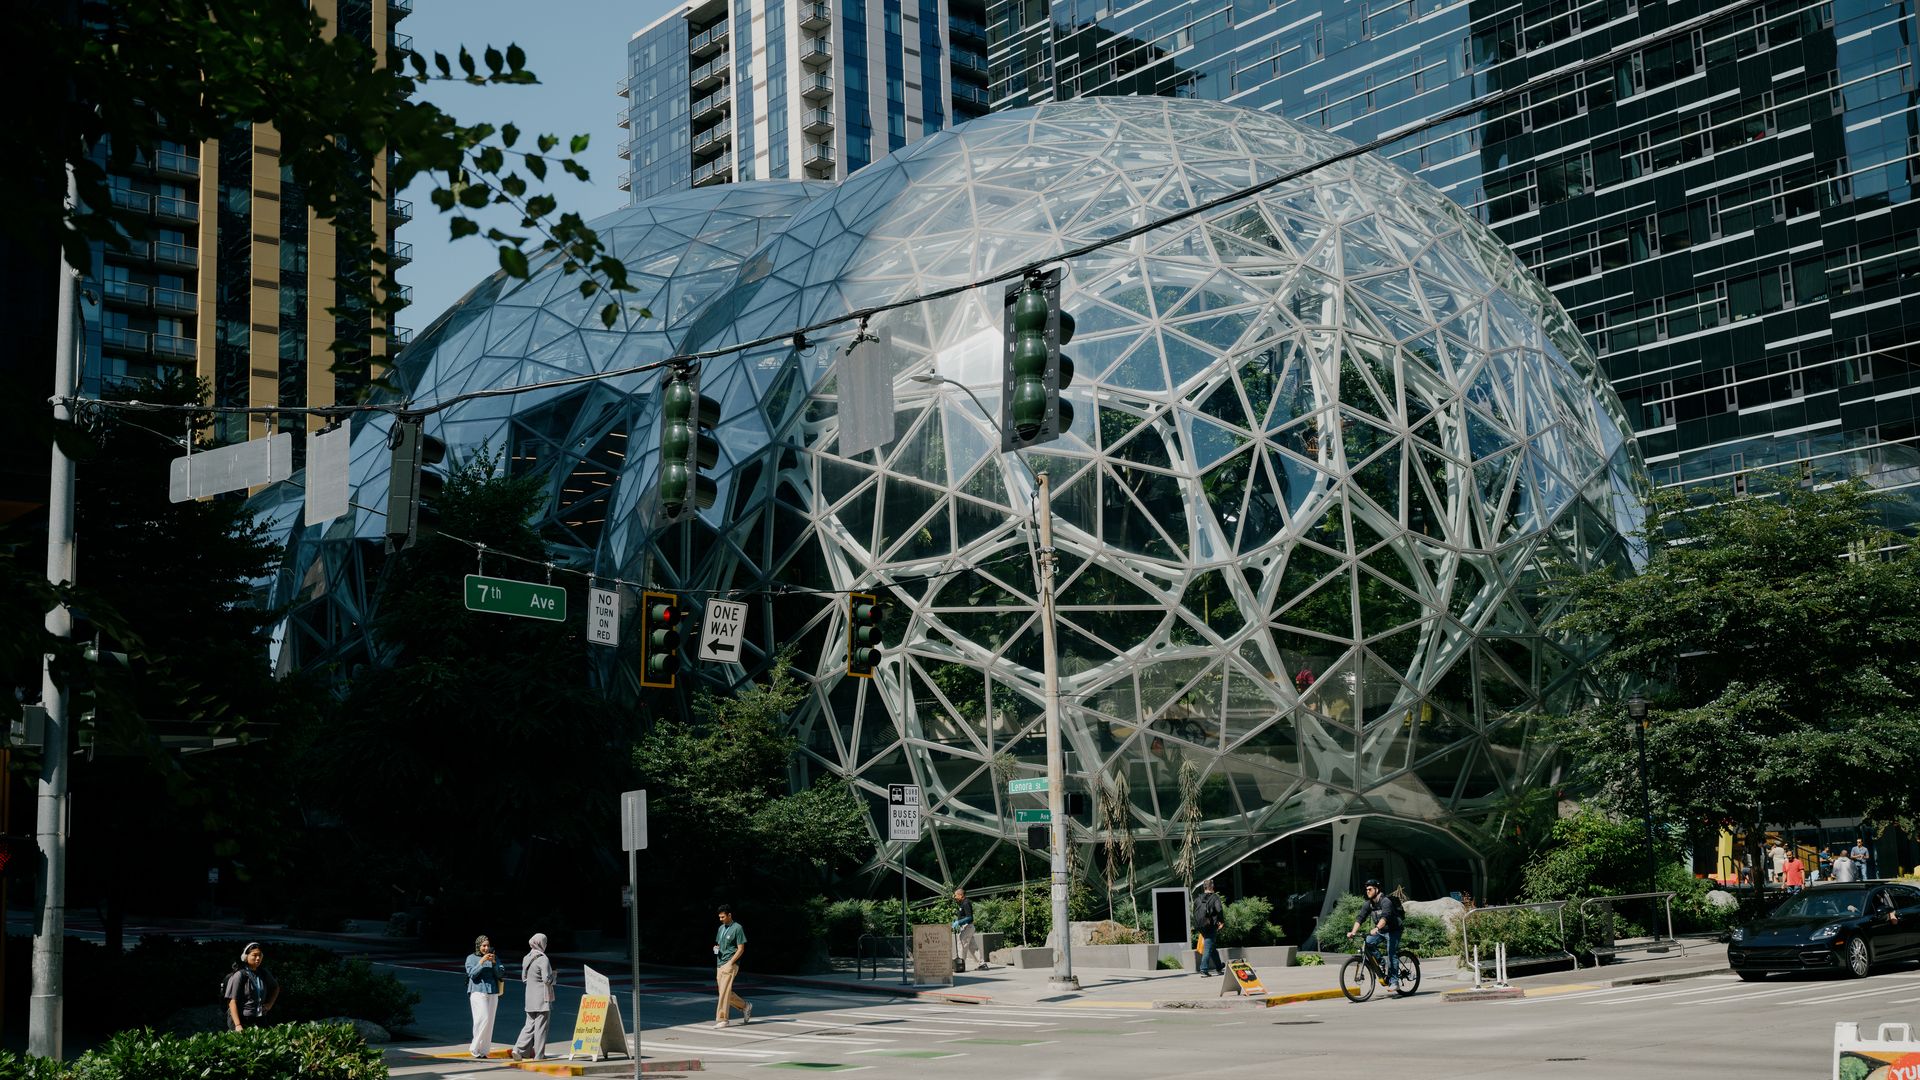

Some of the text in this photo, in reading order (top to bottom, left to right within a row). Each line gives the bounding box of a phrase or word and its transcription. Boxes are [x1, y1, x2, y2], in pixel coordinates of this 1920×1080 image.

[477, 584, 555, 610] 7th Ave
[598, 594, 612, 606] NO
[595, 606, 614, 618] TURN
[713, 605, 739, 622] ONE
[598, 618, 609, 629] ON
[710, 621, 738, 638] WAY
[596, 630, 611, 641] RED
[1011, 782, 1033, 792] Lenora
[892, 809, 917, 819] BUSES
[895, 819, 914, 828] ONLY
[582, 998, 606, 1009] Saffron
[582, 1012, 601, 1024] Spice
